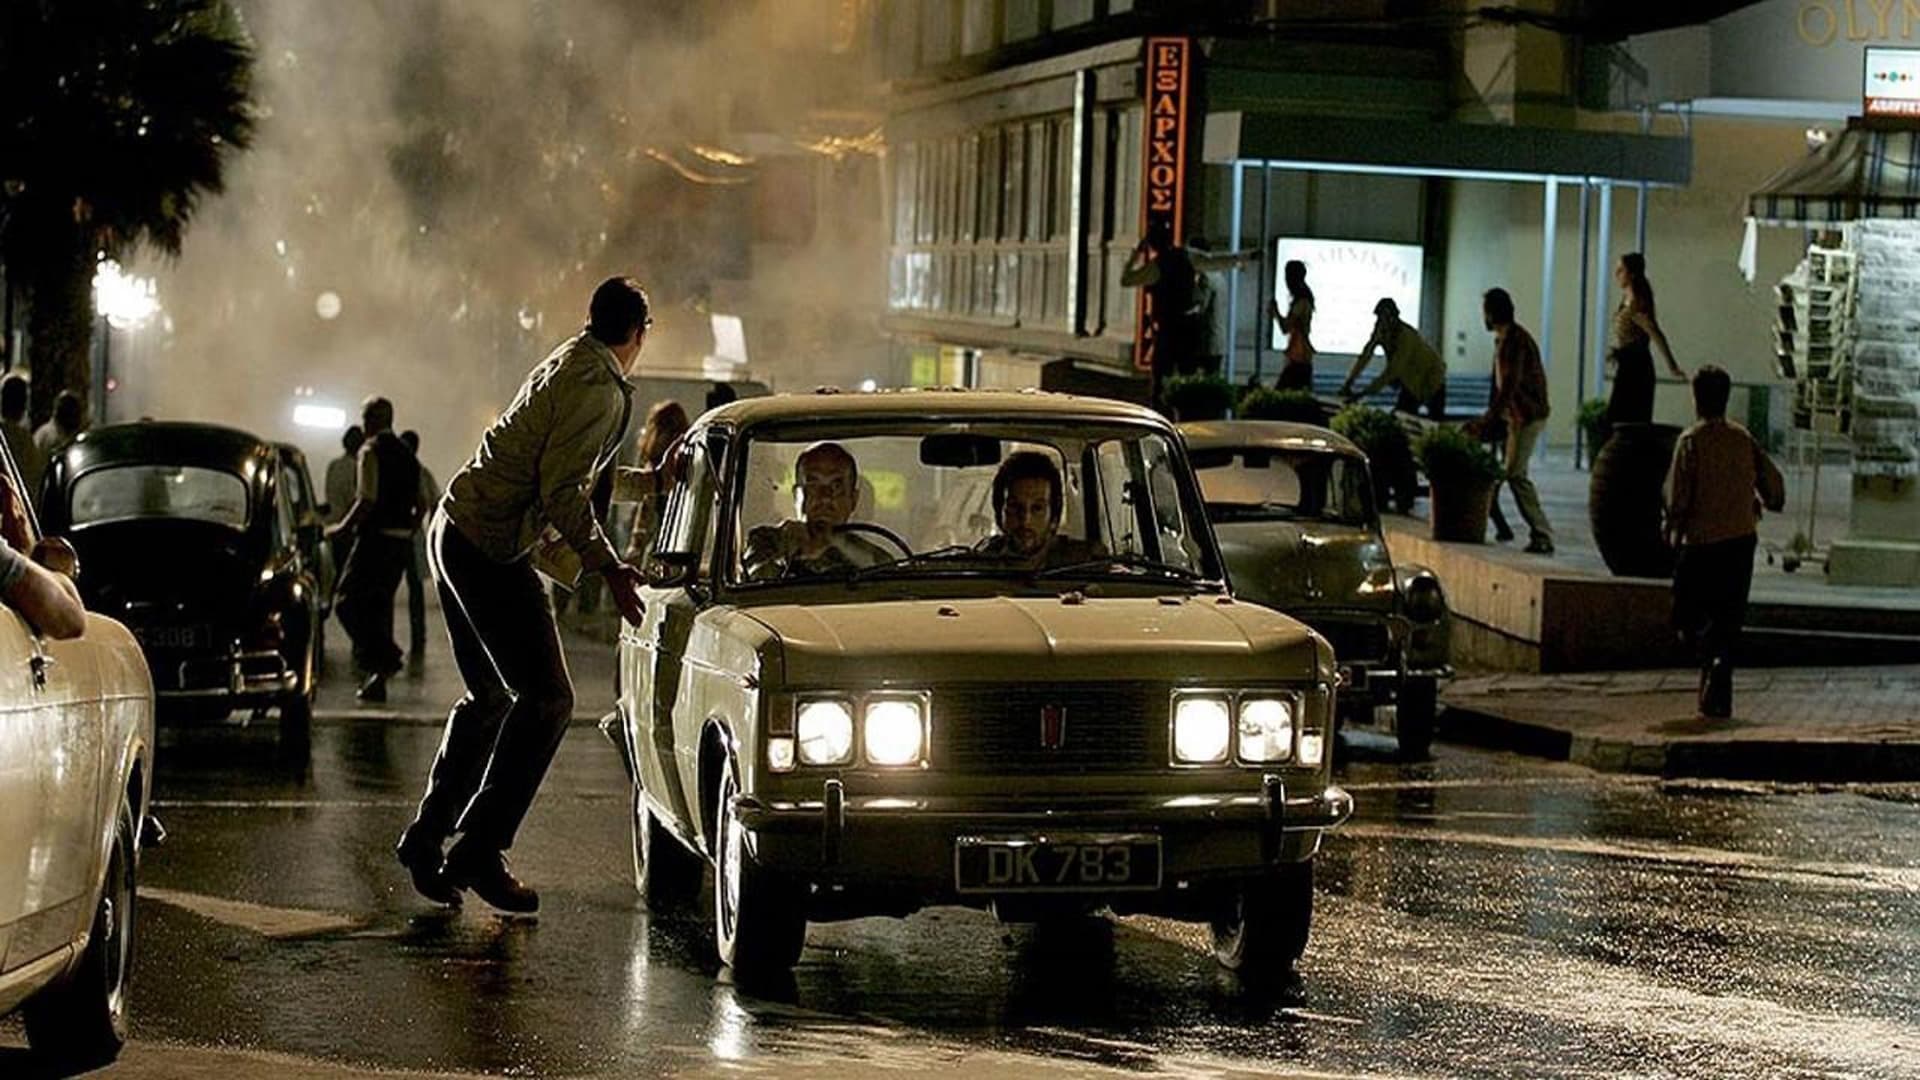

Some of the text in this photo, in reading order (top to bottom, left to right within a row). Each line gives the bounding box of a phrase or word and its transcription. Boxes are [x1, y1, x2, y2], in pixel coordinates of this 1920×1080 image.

[1151, 46, 1178, 210] ΕΞΑΡΧΟΣ
[988, 847, 1131, 883] DK 783
